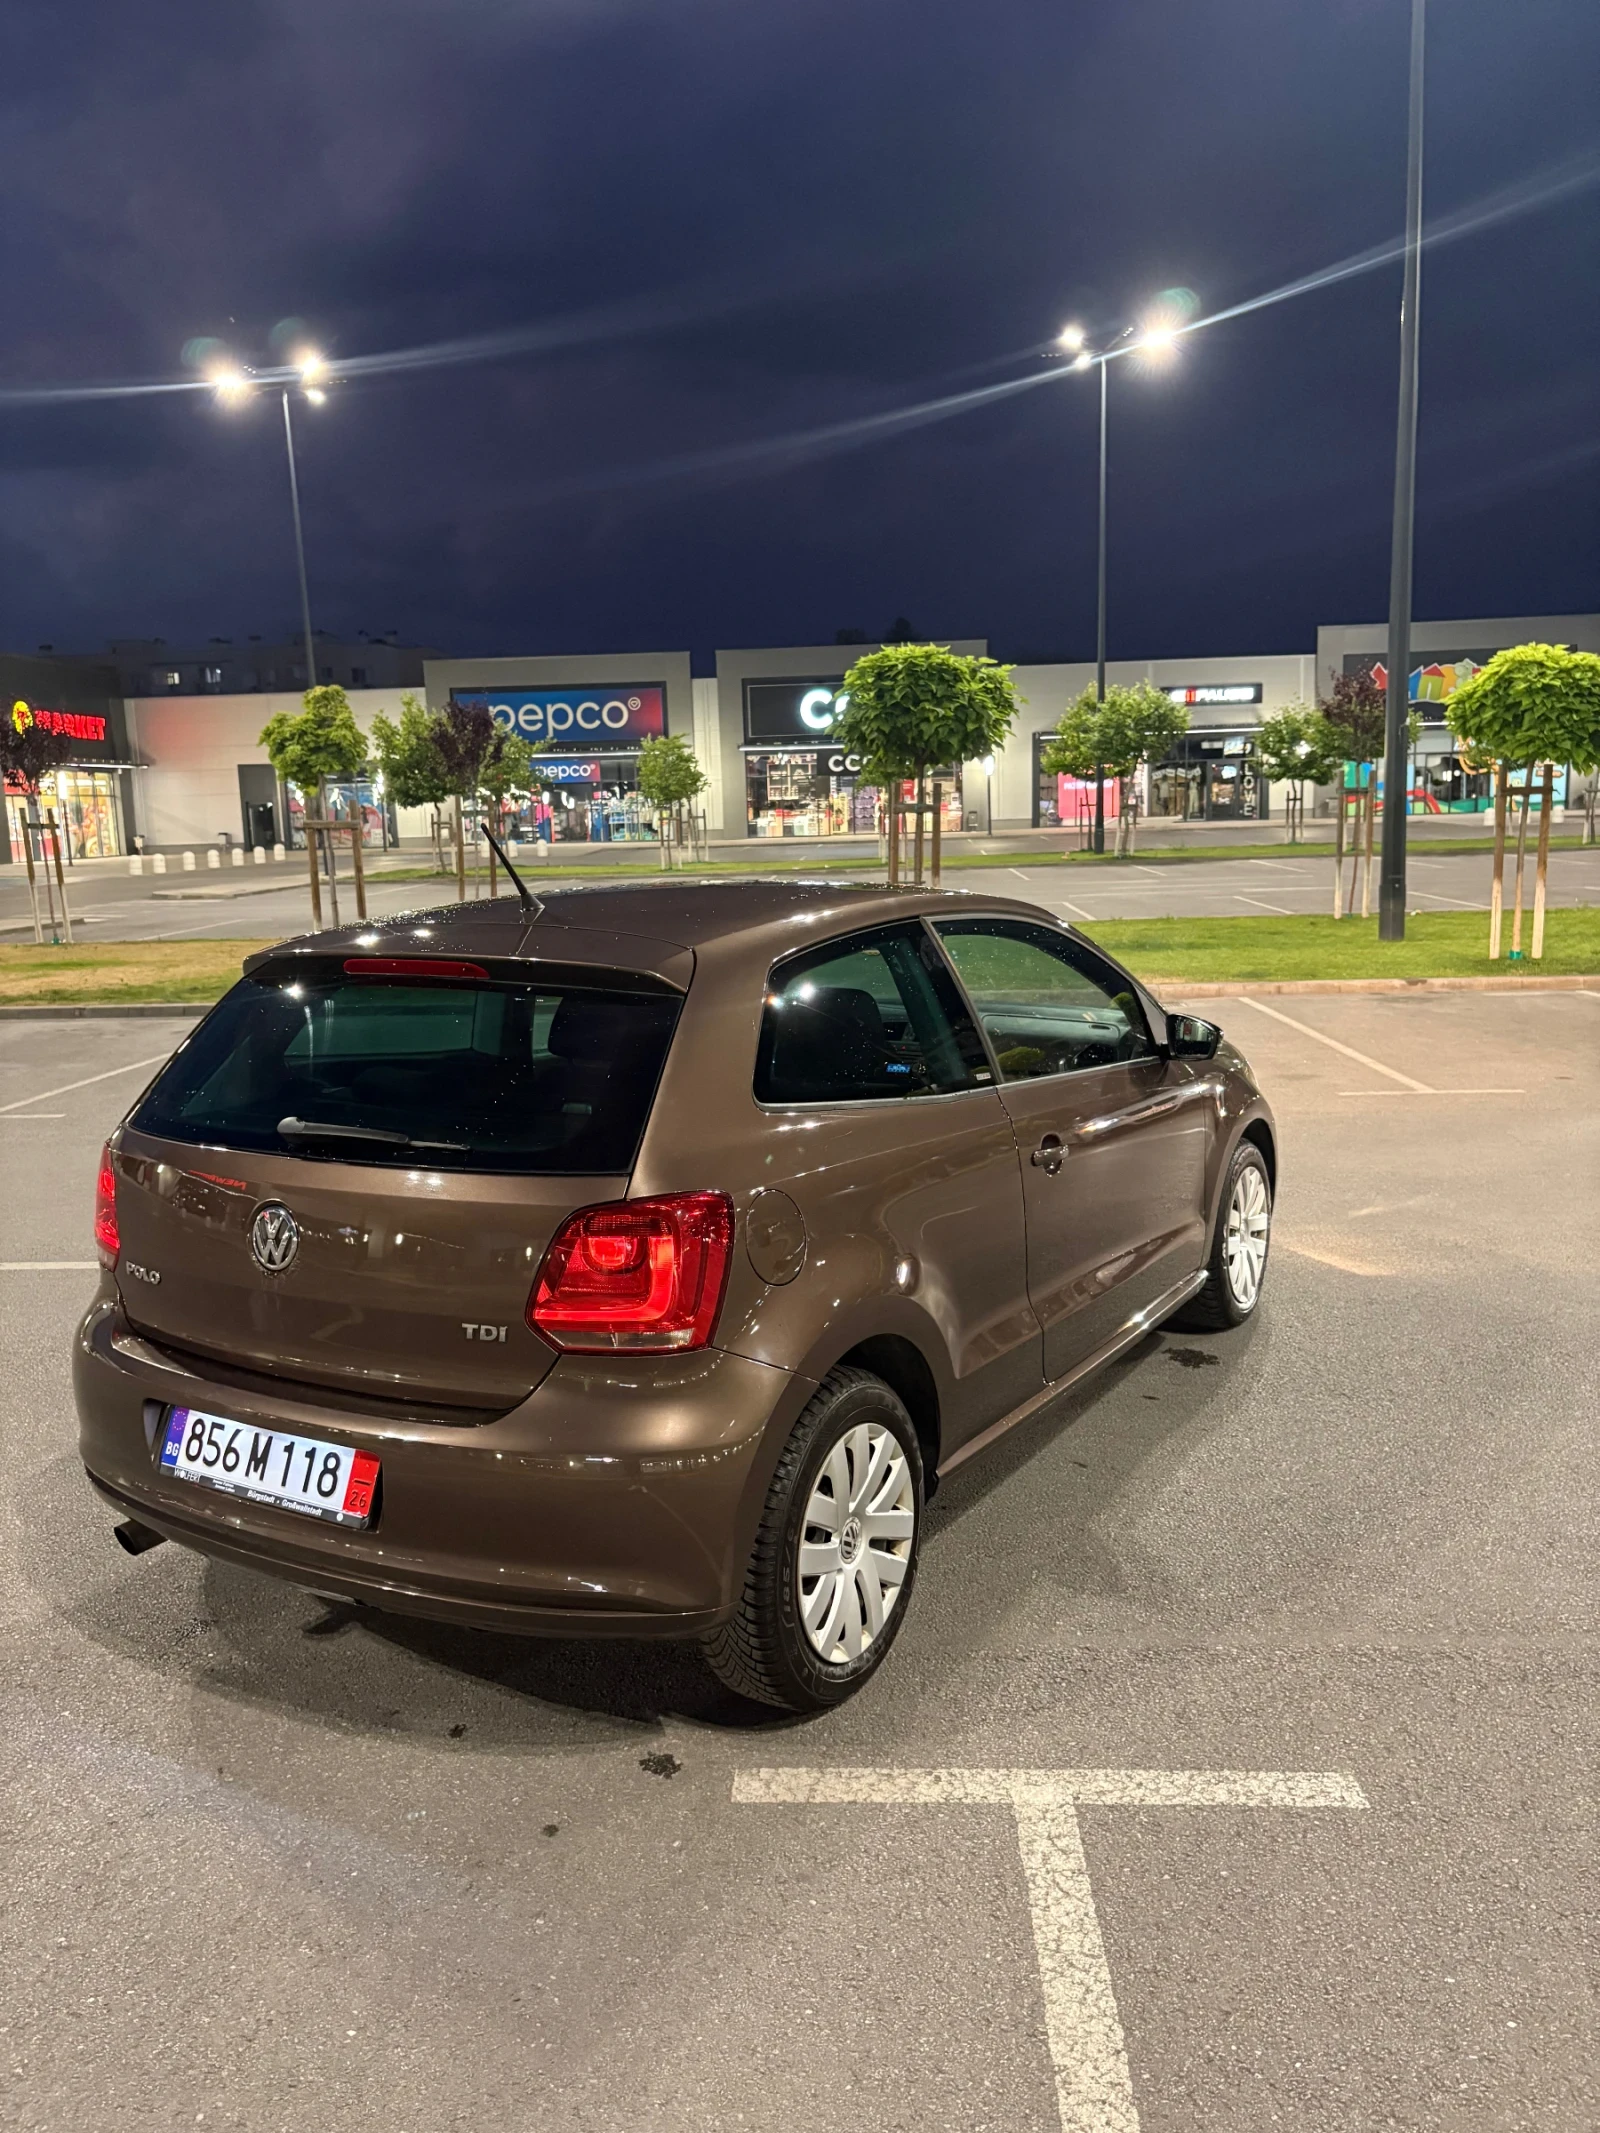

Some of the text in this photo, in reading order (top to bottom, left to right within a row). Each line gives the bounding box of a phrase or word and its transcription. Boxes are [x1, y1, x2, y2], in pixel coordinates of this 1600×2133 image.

[488, 701, 629, 738] pepco
[126, 1261, 161, 1285] POLO
[461, 1323, 508, 1342] TDI
[165, 1441, 179, 1457] BG
[349, 1490, 366, 1507] 26
